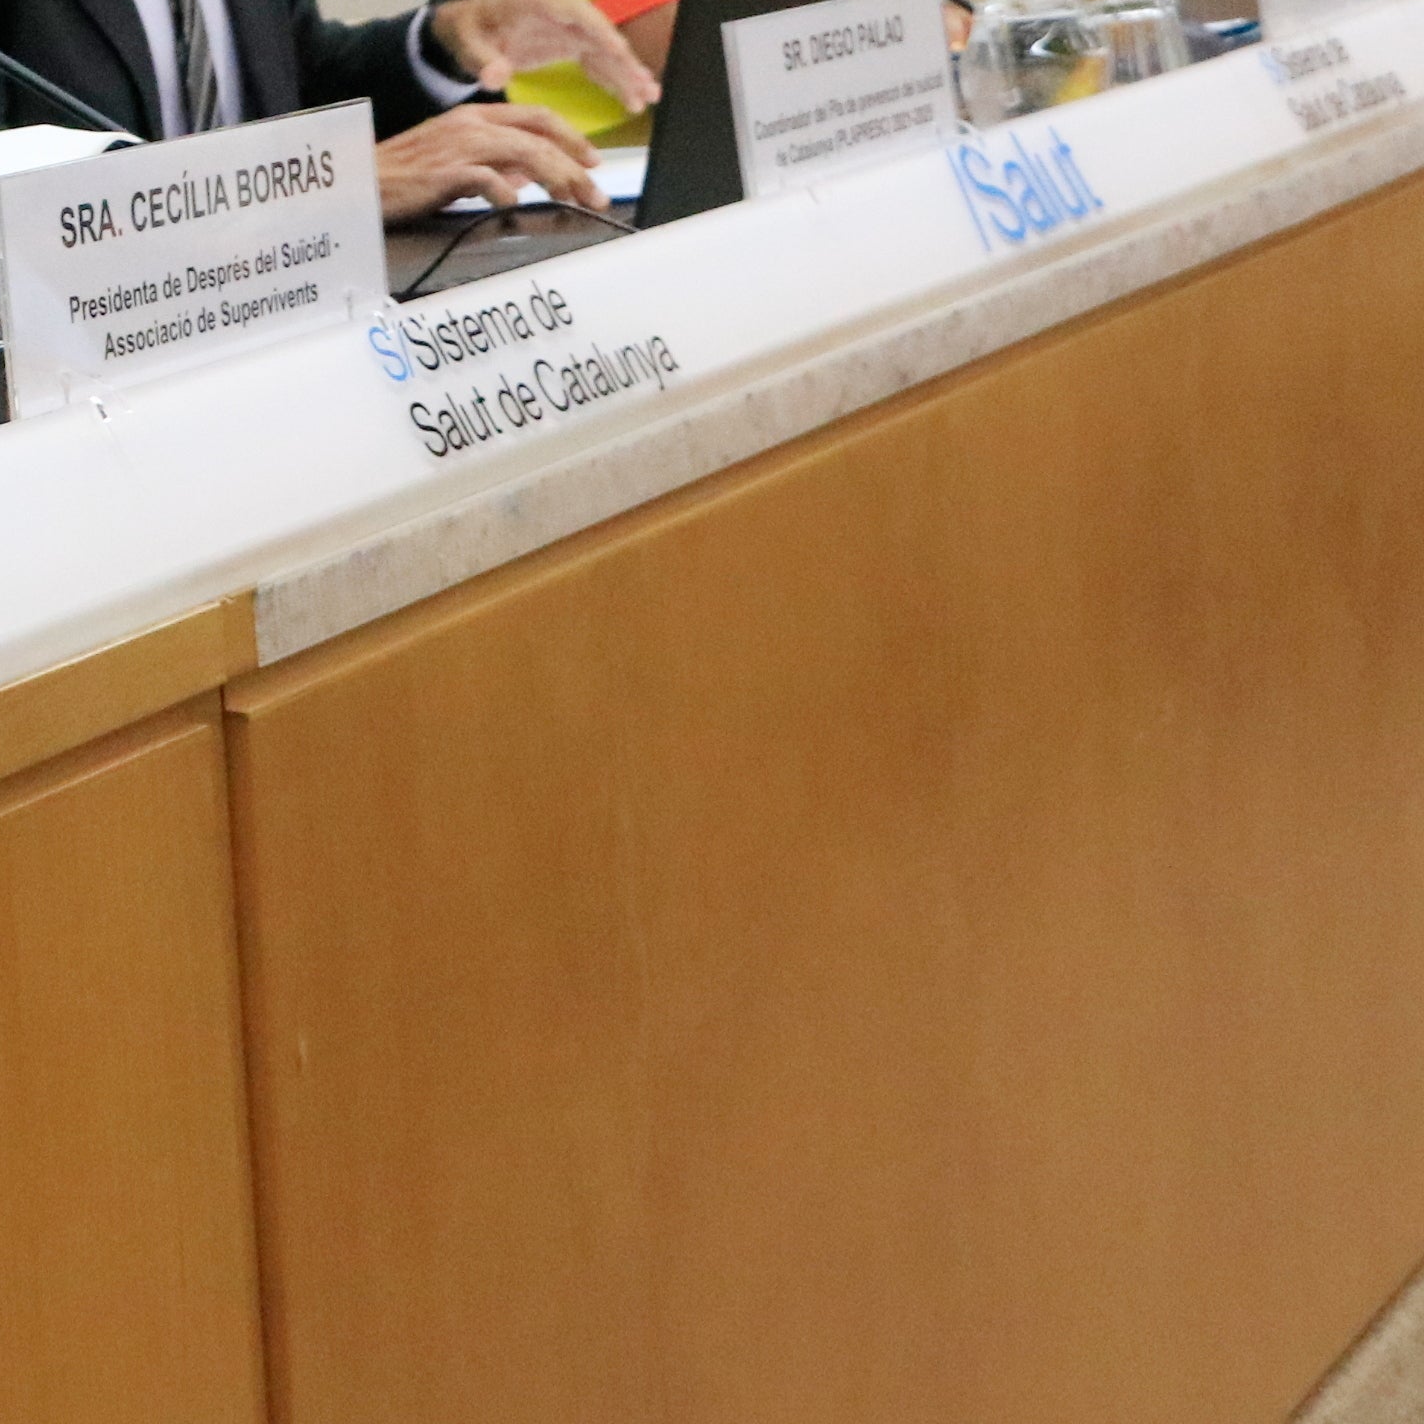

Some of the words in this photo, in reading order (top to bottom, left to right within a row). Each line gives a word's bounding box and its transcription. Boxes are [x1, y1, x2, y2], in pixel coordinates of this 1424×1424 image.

[60, 197, 124, 249] SRA.
[130, 169, 230, 232] CECÍLIA
[236, 144, 336, 208] BORRÀS
[69, 280, 158, 324] Presidenta
[162, 271, 182, 300] de
[186, 254, 251, 293] Després
[255, 246, 279, 275] del
[281, 231, 332, 269] Suïcidi
[104, 308, 193, 360] Associació
[197, 306, 217, 334] de
[220, 279, 320, 327] Supervivents
[529, 279, 574, 332] de
[409, 386, 504, 458] Salut
[498, 373, 544, 428] de
[533, 335, 680, 414] Catalunya
